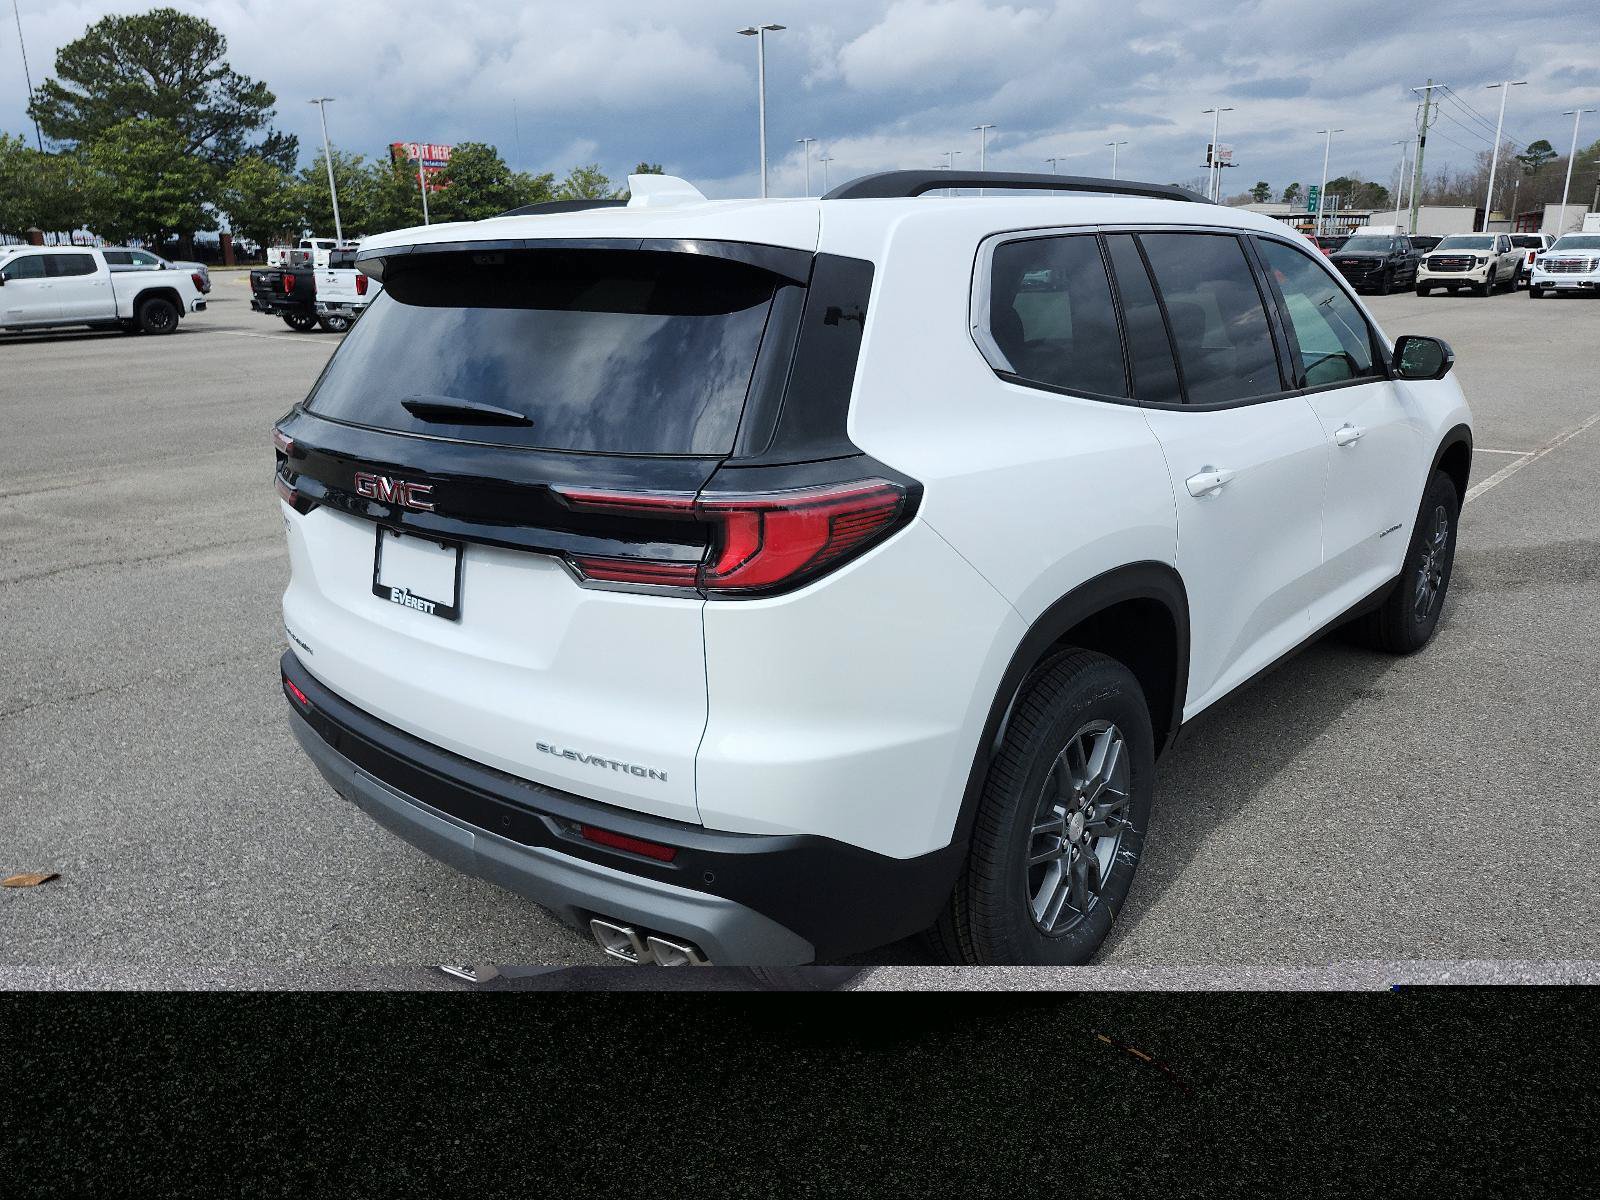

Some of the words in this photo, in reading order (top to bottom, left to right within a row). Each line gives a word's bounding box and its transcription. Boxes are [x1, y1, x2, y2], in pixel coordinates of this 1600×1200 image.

[355, 472, 435, 511] GMC
[391, 587, 436, 615] EVERETT
[536, 741, 668, 782] ELEVATION
